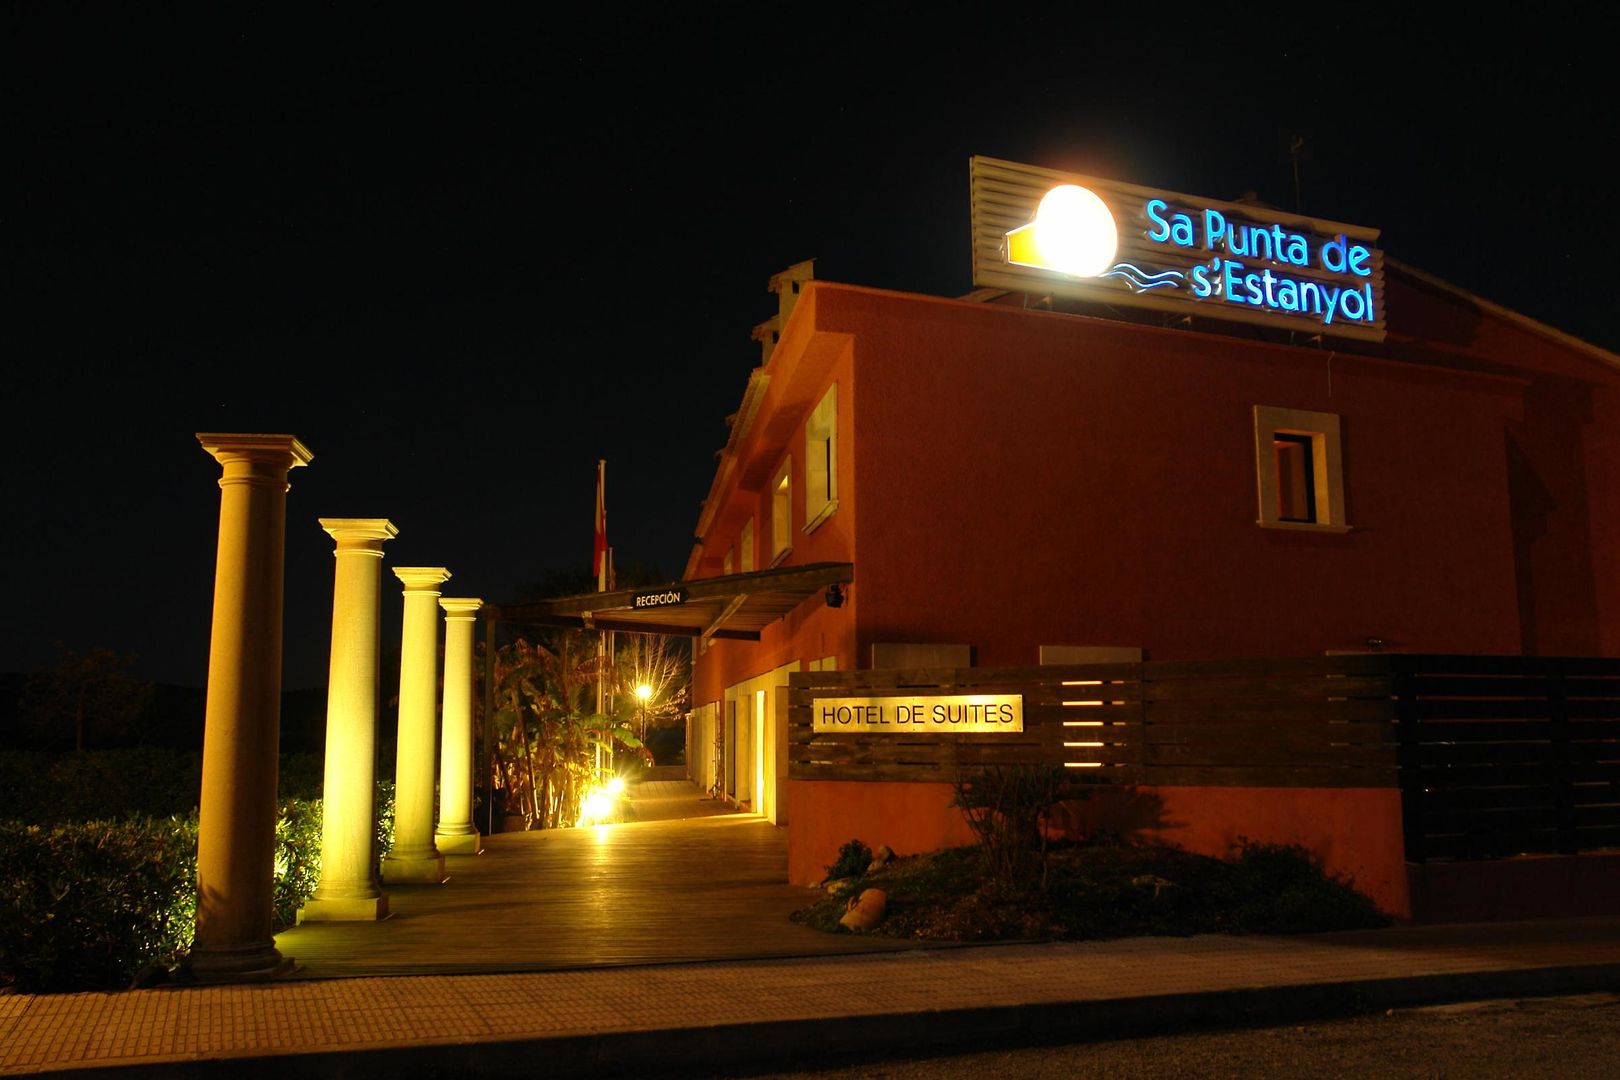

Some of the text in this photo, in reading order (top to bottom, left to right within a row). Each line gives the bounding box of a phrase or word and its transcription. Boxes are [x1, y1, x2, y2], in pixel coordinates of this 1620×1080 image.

[1146, 199, 1372, 277] Sa Punta de
[1191, 256, 1374, 325] s'Estanyol
[636, 590, 681, 607] RECEPCIÓN
[822, 704, 1014, 724] HOTEL DE SUITES
